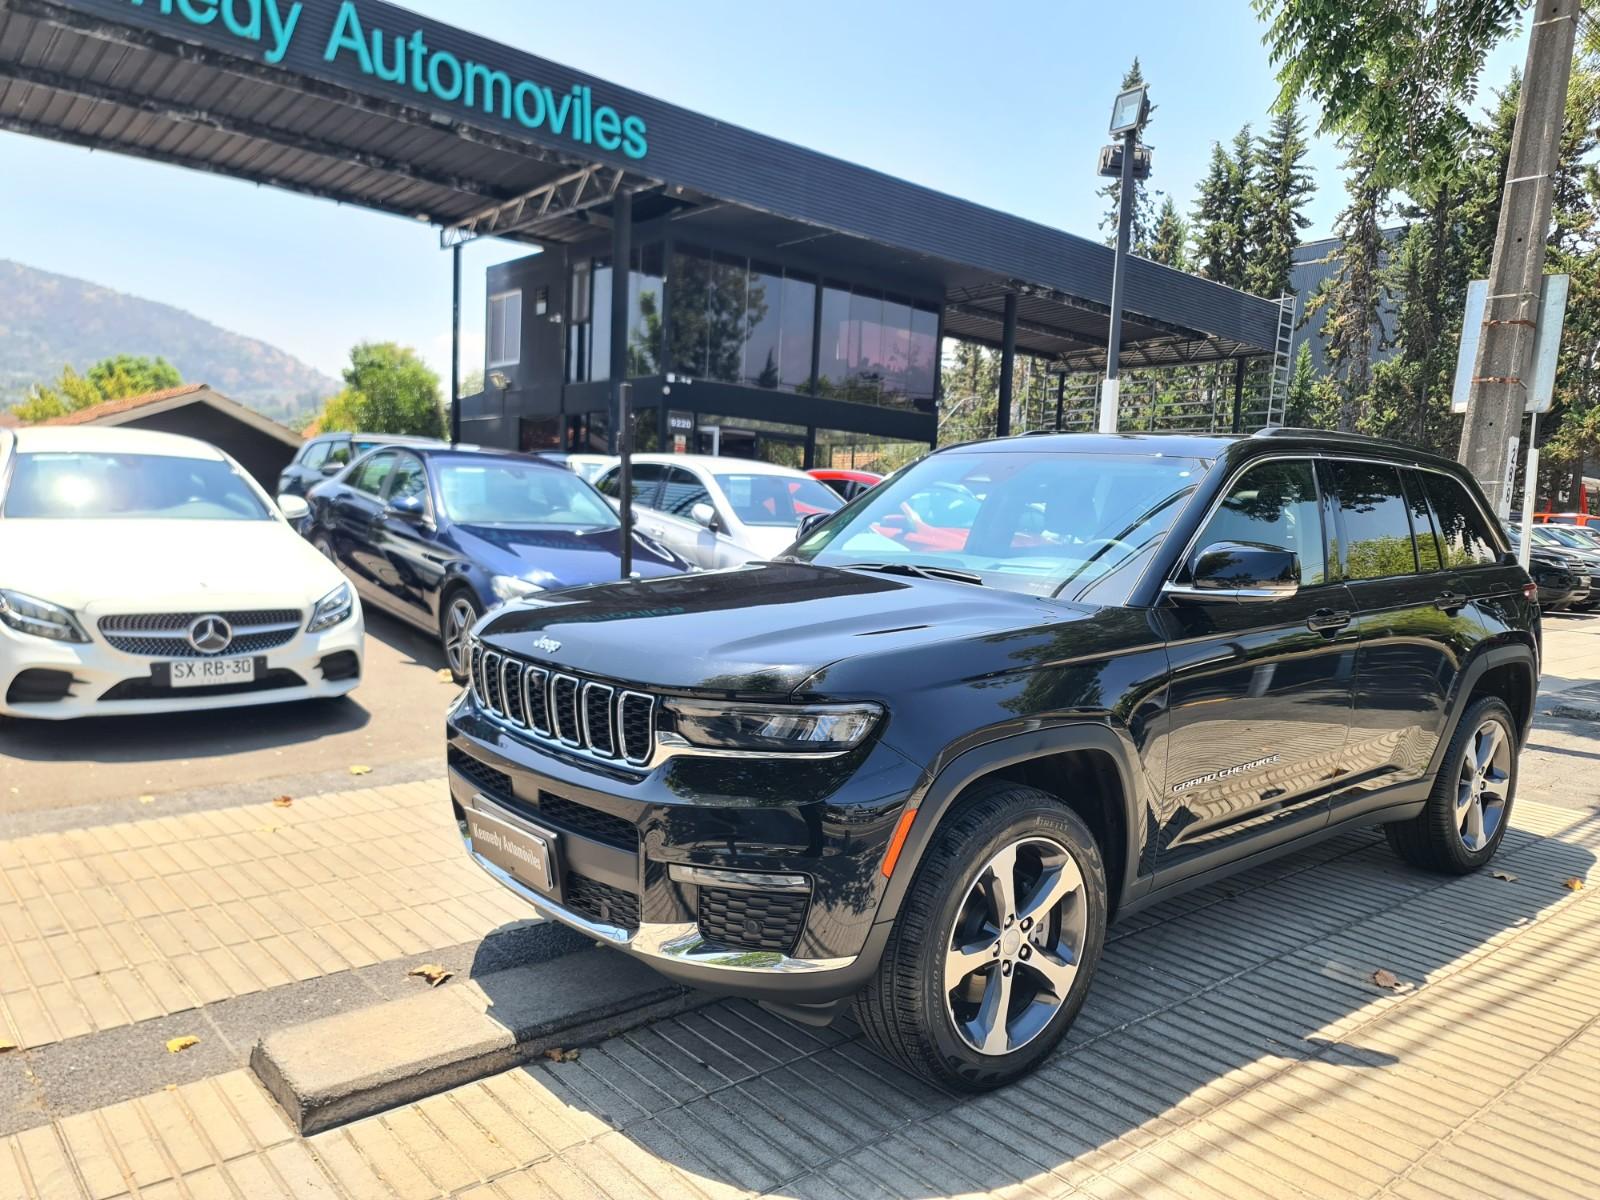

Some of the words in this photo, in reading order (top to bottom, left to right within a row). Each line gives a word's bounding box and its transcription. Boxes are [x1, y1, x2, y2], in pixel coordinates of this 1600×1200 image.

[324, 1, 648, 159] Automoviles
[533, 635, 562, 653] Jeep
[1173, 773, 1216, 792] GRAND
[1218, 754, 1280, 778] CHEROKEE
[472, 823, 502, 851] Kennedy
